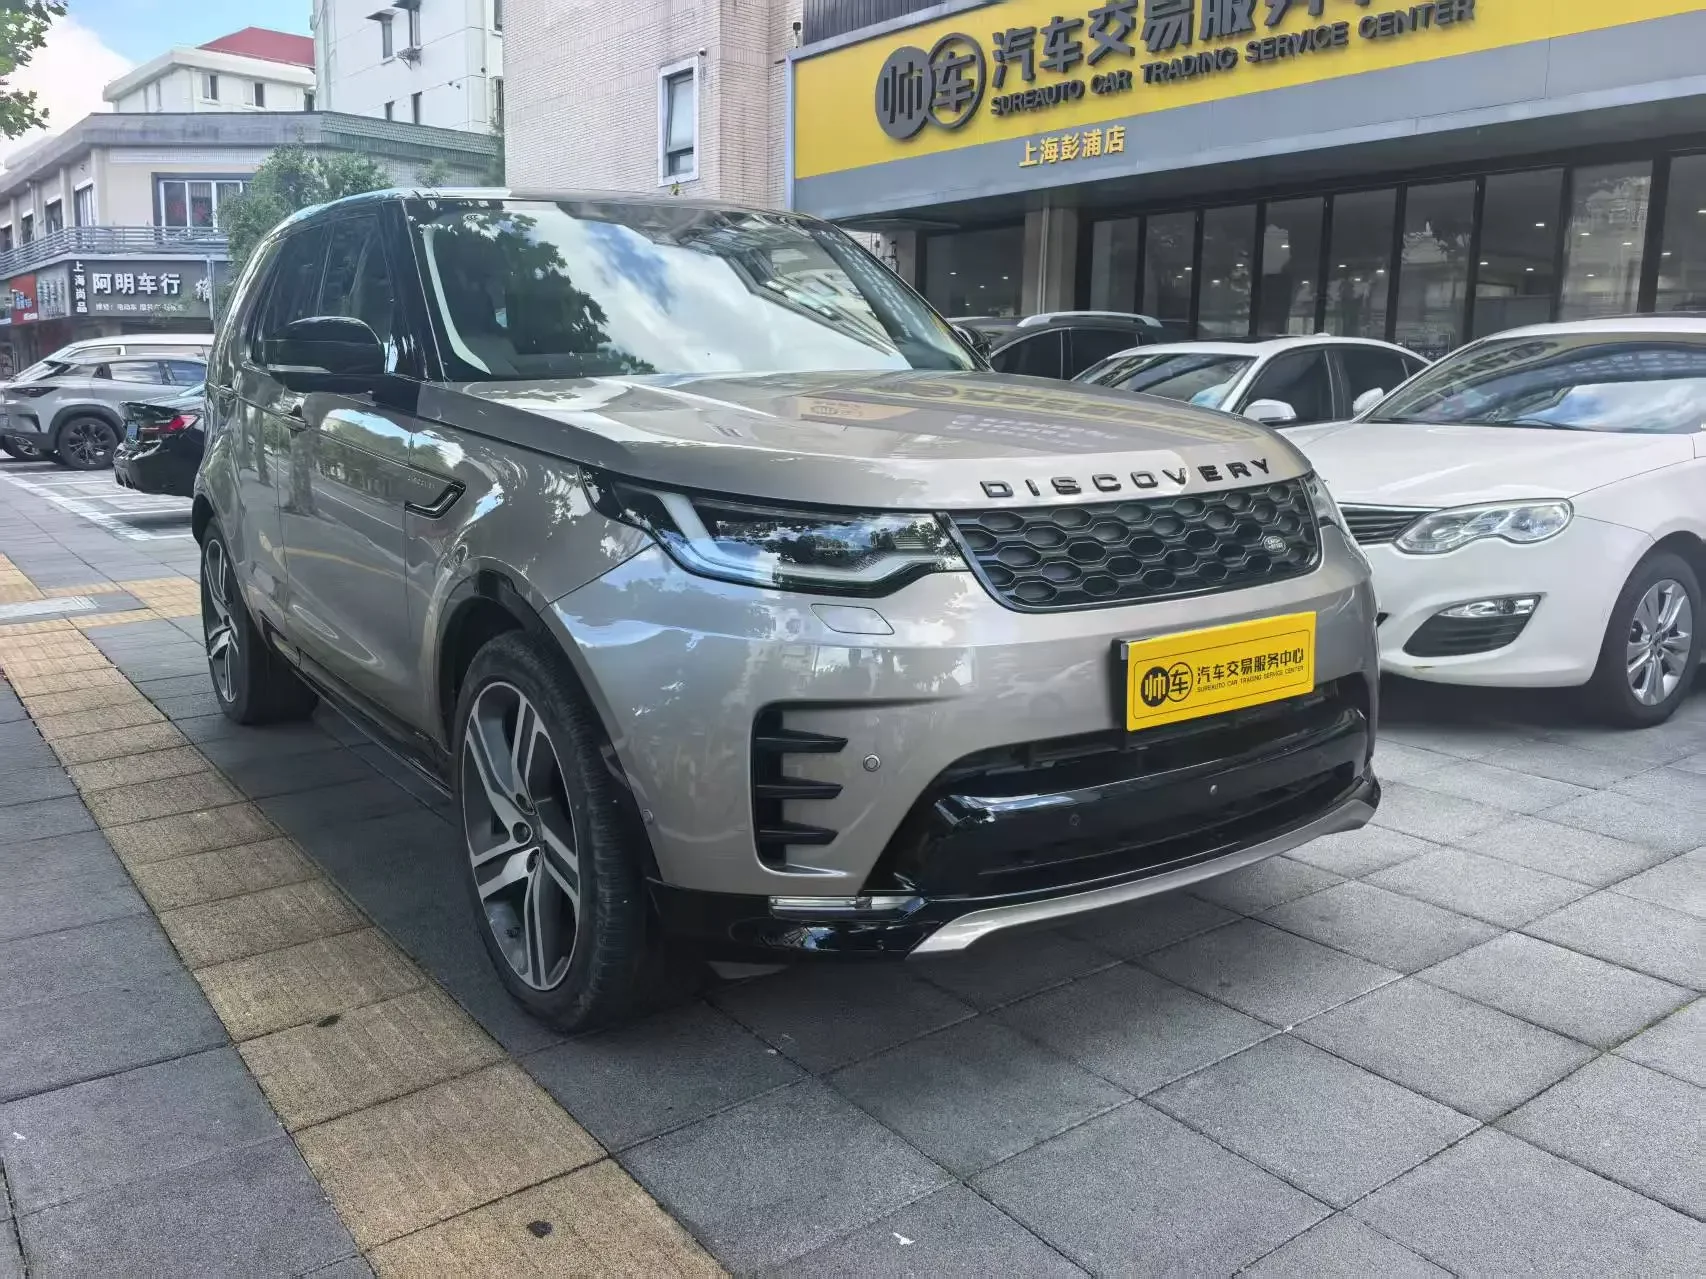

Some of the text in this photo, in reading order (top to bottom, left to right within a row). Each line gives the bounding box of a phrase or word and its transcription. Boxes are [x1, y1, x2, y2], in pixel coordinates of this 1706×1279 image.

[990, 0, 1476, 117] SUREAUTO CAR TRADING SERVICE CENTER
[881, 50, 978, 125] 帅车
[1018, 124, 1126, 168] 上海彭浦店
[73, 261, 88, 313] 上海尚品
[92, 272, 181, 295] 阿明车行
[979, 457, 1271, 499] DISCOVERY
[1144, 669, 1189, 702] 帅车
[1197, 647, 1304, 685] 汽车交易服务中心
